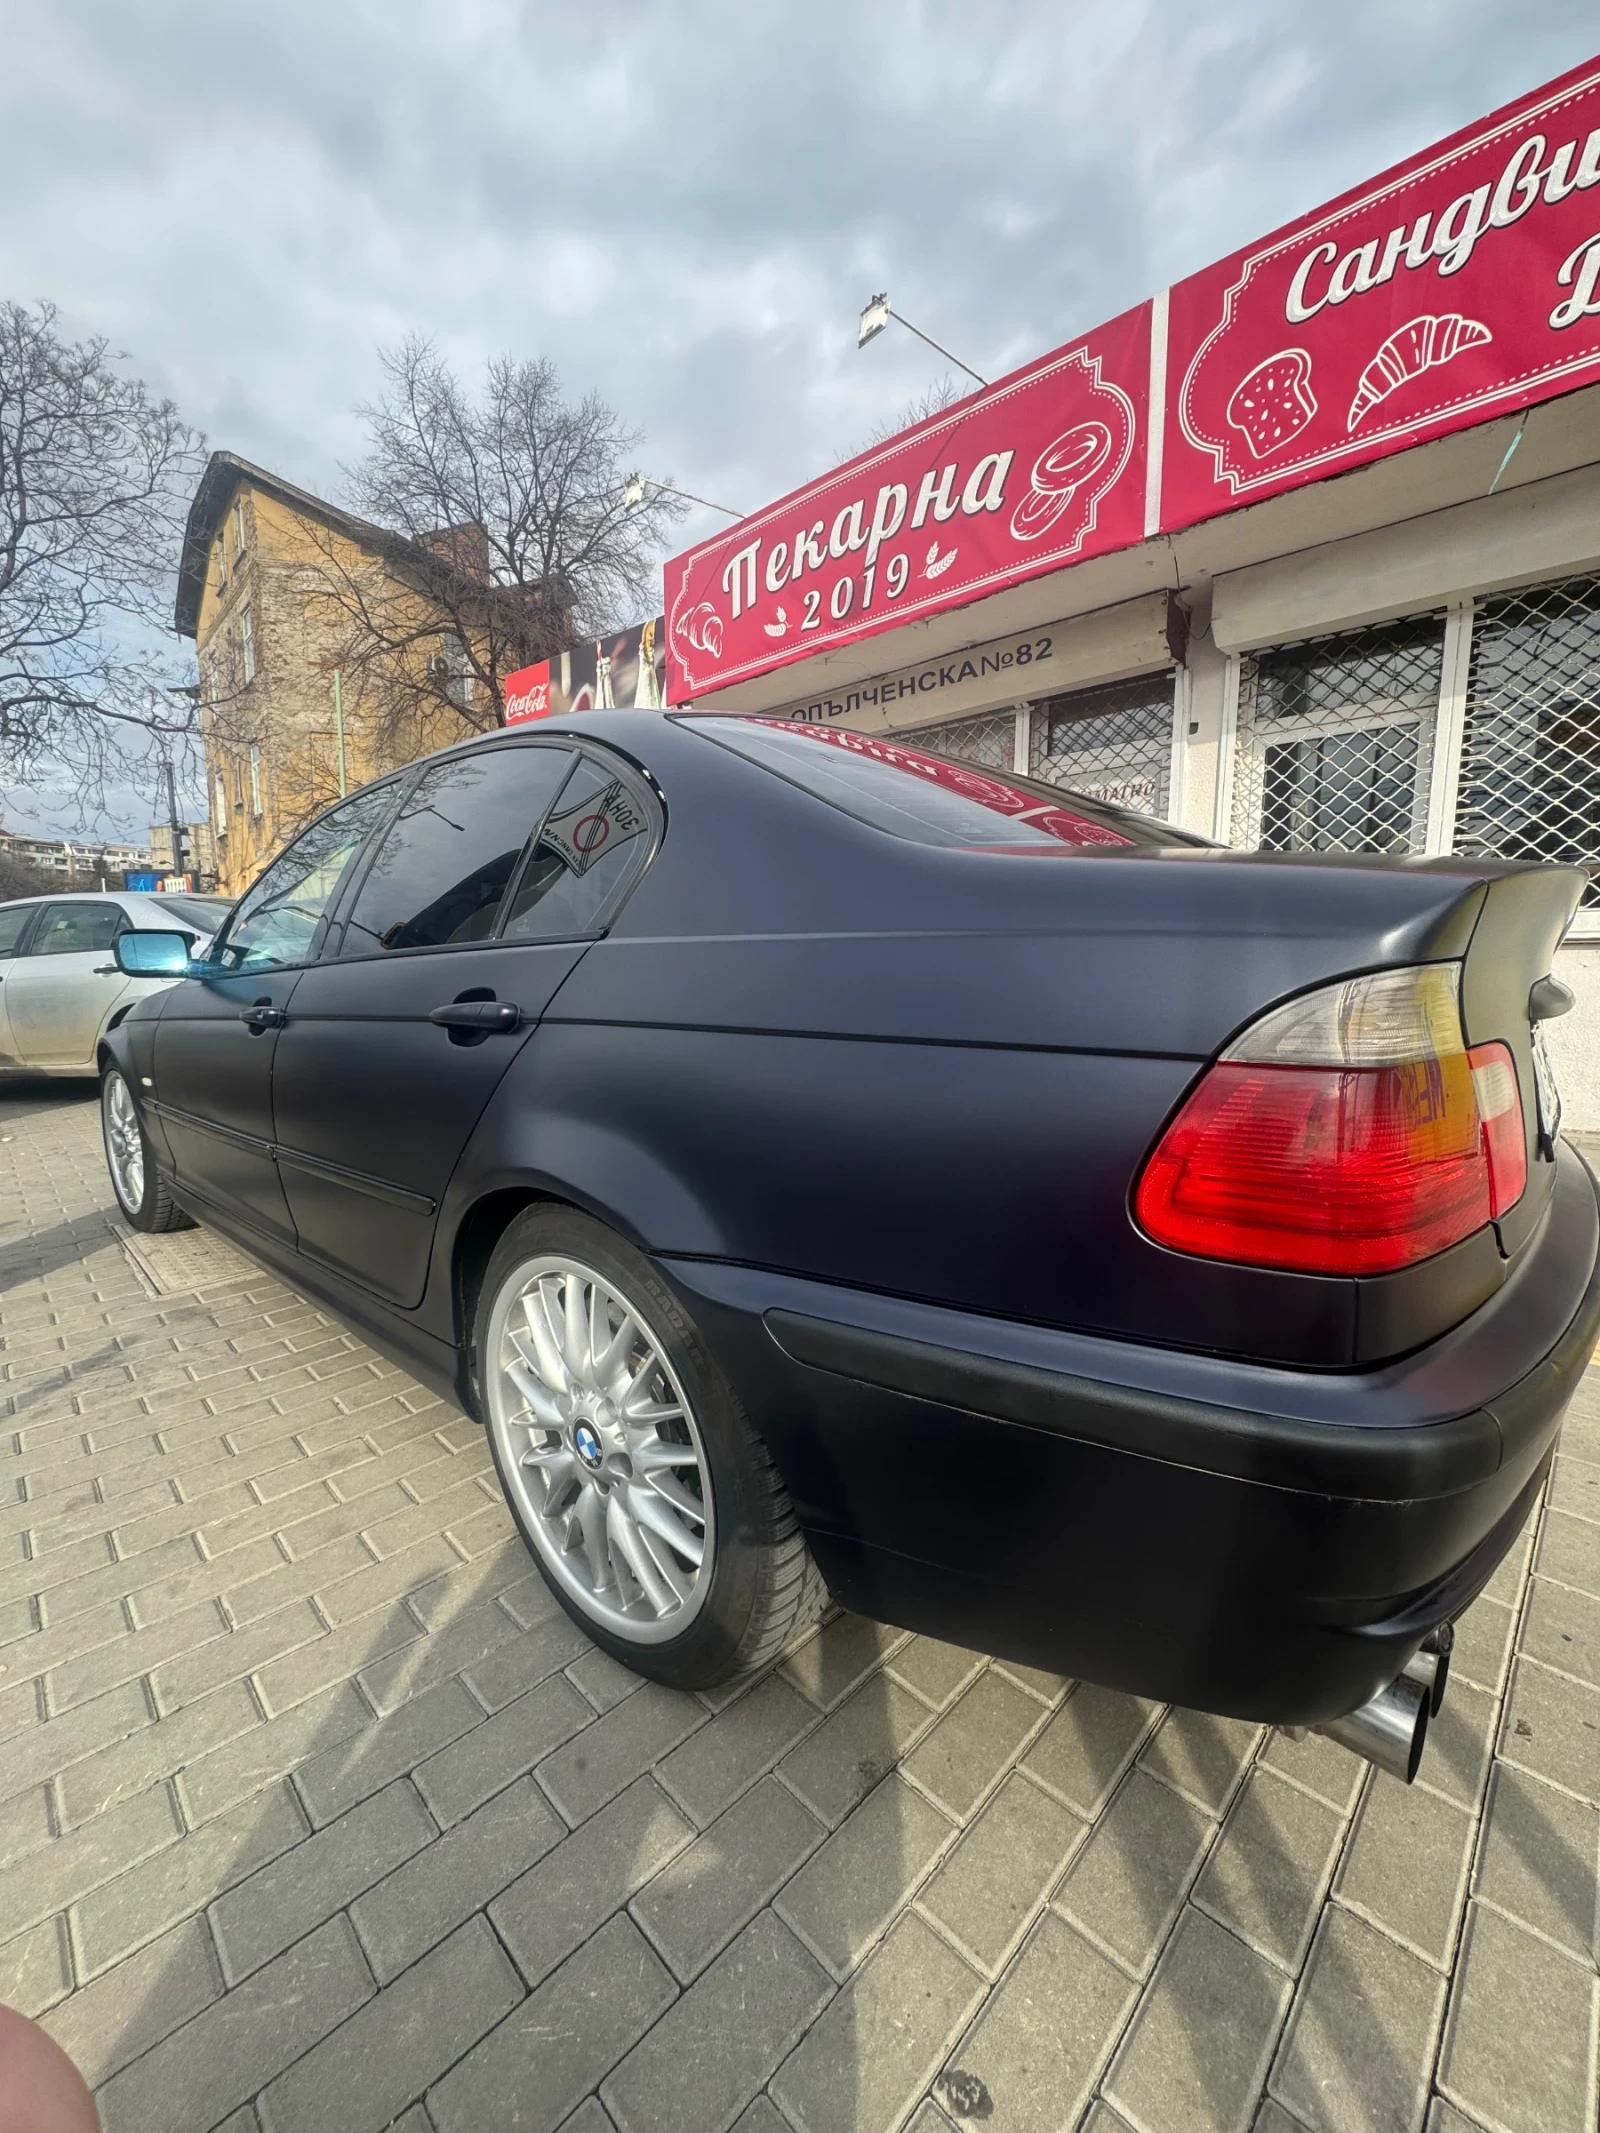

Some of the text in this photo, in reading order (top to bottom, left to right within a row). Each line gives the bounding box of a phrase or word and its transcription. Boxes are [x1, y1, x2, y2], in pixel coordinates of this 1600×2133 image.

[722, 450, 1016, 620] Пекарна
[800, 553, 910, 631] 2019
[506, 683, 549, 721] Coca-Cola
